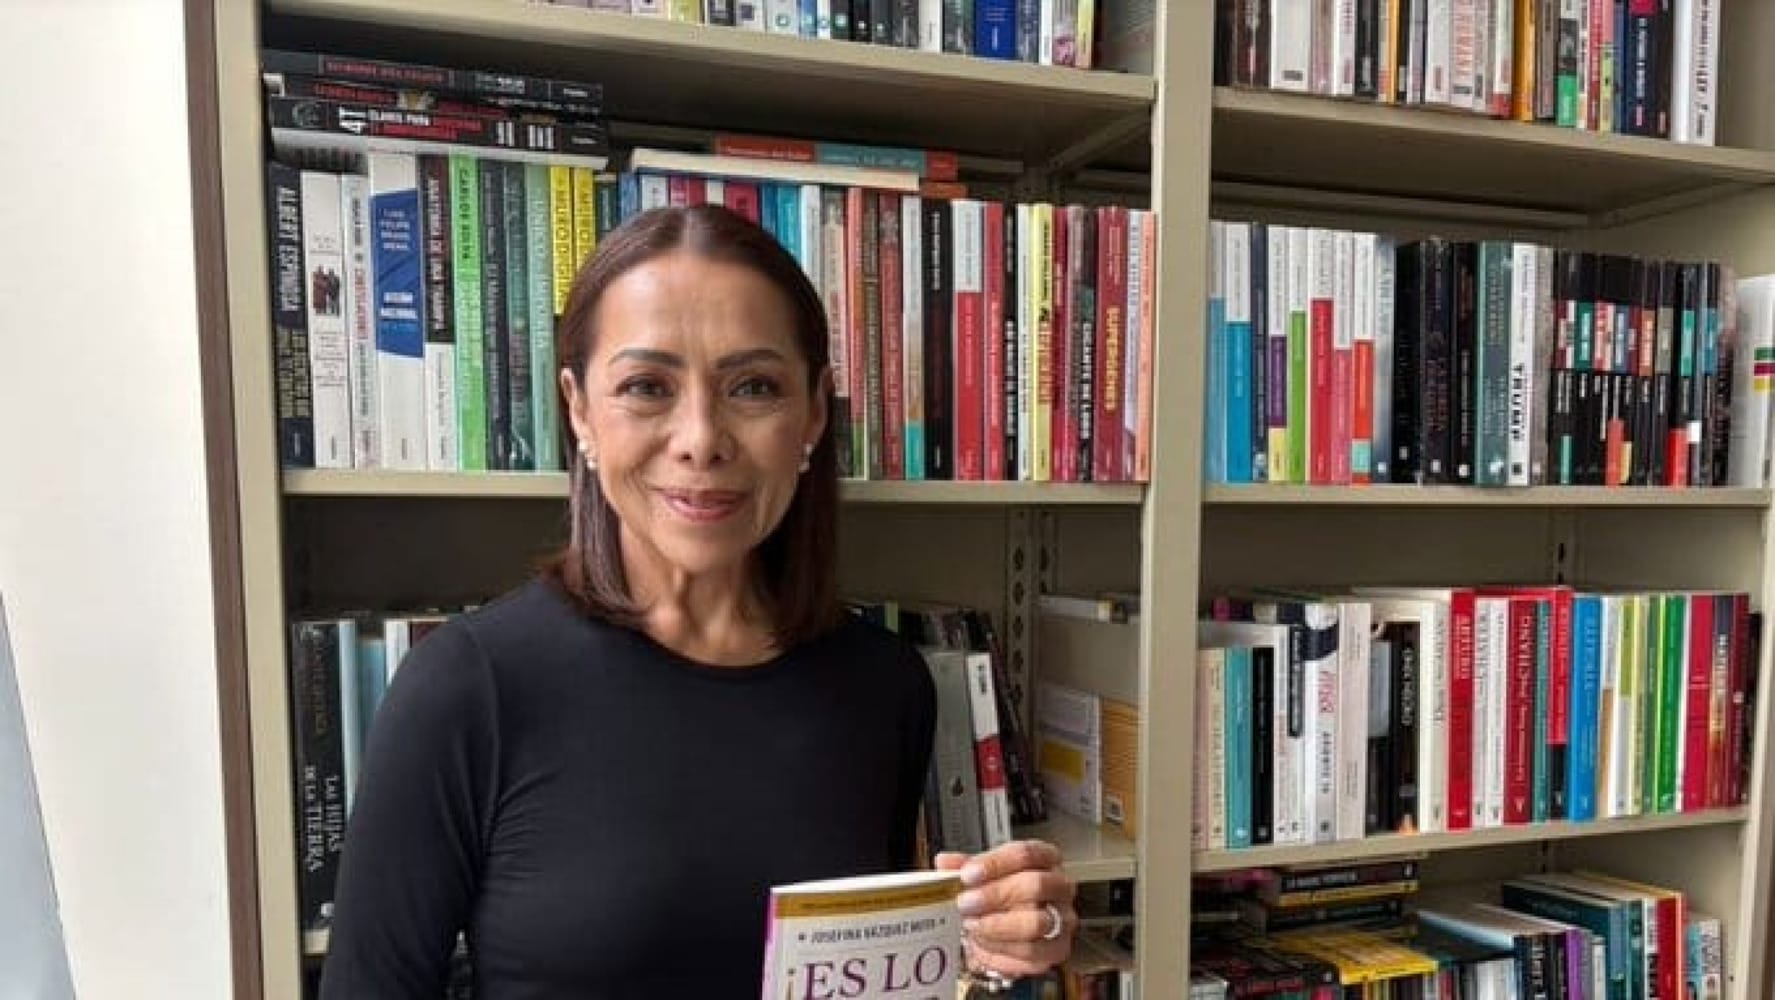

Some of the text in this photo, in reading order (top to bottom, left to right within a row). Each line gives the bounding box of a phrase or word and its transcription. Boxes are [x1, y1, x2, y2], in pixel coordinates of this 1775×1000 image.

[278, 186, 301, 312] ALBERT ESPINOSA
[1511, 362, 1524, 442] TRUMP
[306, 803, 325, 872] TIERRA
[810, 928, 862, 944] JOSEFINA
[882, 944, 947, 993] LO
